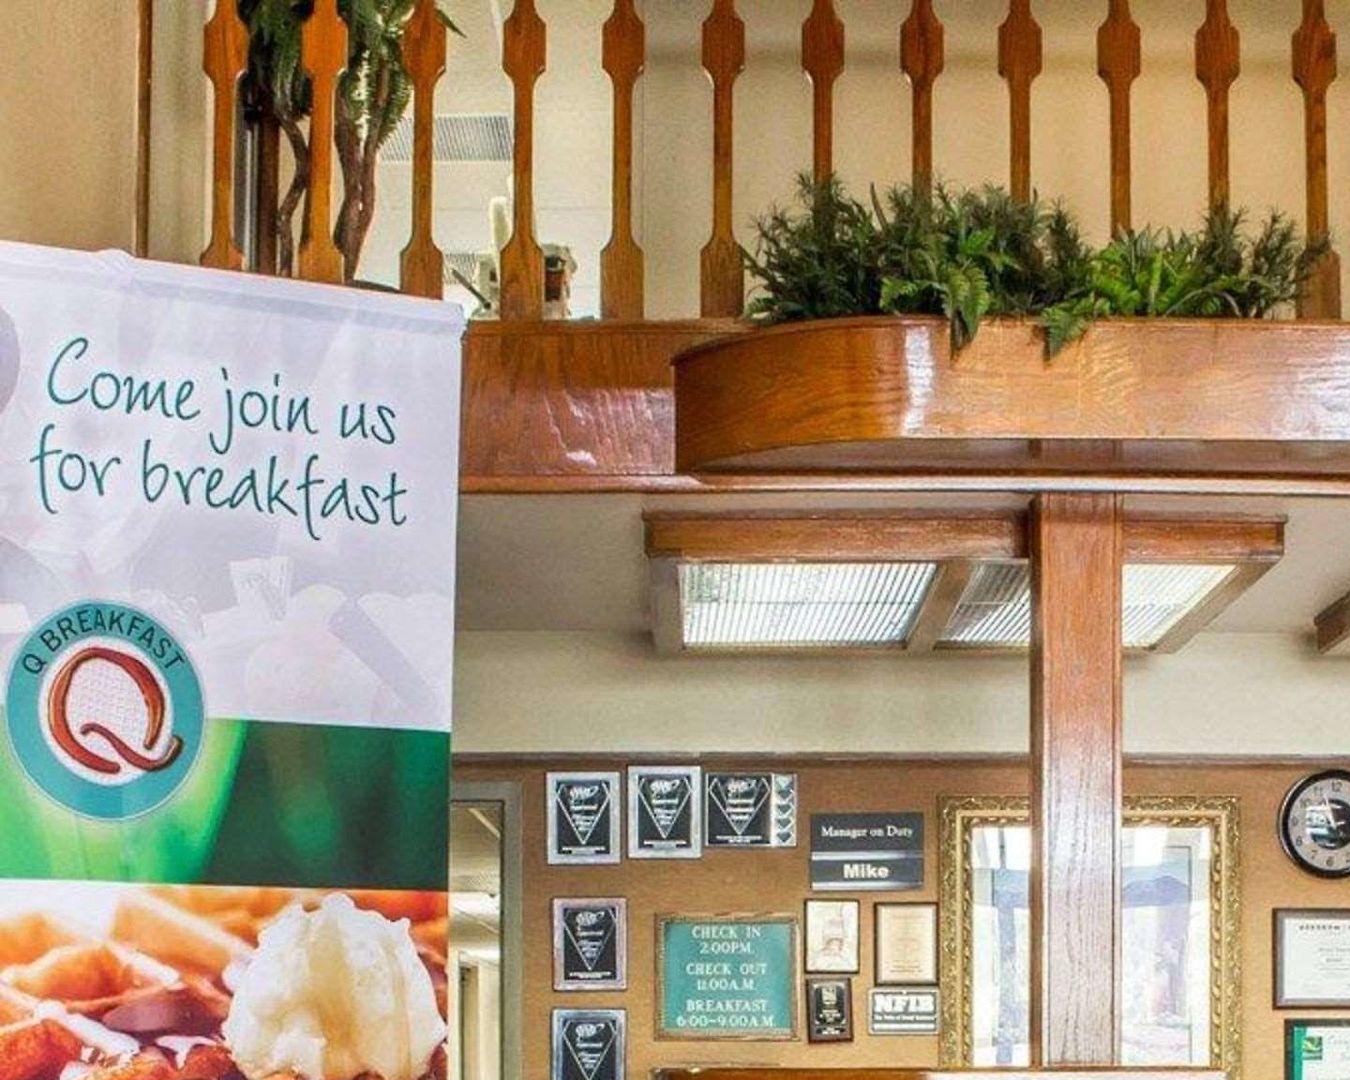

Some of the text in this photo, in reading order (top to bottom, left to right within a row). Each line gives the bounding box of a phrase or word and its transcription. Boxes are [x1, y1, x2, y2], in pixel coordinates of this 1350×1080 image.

[48, 337, 397, 454] Come join us
[29, 423, 408, 540] for breakfast
[22, 609, 186, 674] Q BREAKFAST
[48, 647, 183, 774] Q
[821, 825, 913, 839] Manager on Duty
[843, 863, 889, 878] Mike
[691, 926, 761, 939] CHECK IN
[686, 963, 767, 975] CHECK OUT
[686, 999, 769, 1012] BREAKFAST
